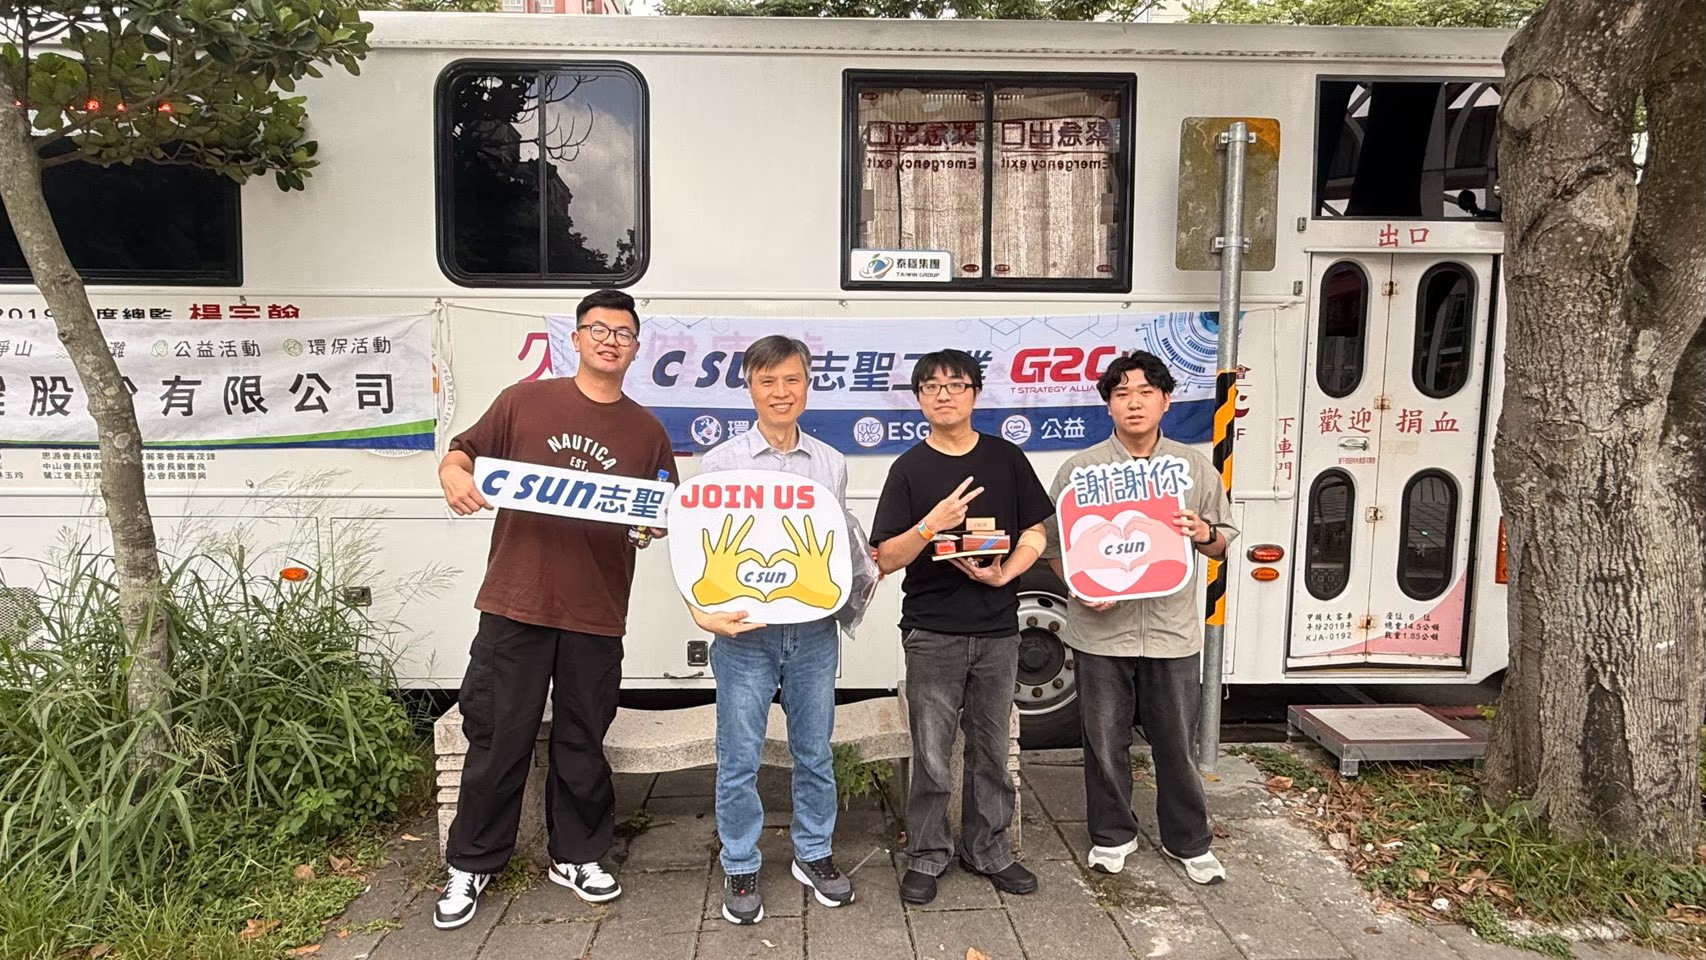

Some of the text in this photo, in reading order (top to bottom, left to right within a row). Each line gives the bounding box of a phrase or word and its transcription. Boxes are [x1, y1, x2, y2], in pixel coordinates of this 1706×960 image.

[1378, 223, 1430, 248] 出口
[173, 339, 261, 358] 公益活動
[307, 336, 391, 356] 環保活動
[694, 350, 748, 390] su
[1017, 386, 1068, 394] STRATEGY
[727, 420, 759, 439] 環
[887, 421, 930, 441] ESG
[1040, 417, 1086, 440] 公益
[546, 433, 617, 471] NAUTICA
[1275, 417, 1295, 480] 下車門
[1074, 459, 1188, 506] 謝謝你
[513, 473, 597, 510] sun
[594, 484, 666, 520] 志聖
[680, 484, 816, 510] JOIN US
[1115, 539, 1146, 555] sun
[755, 570, 788, 584] sun
[1305, 631, 1353, 642] KJA-0192
